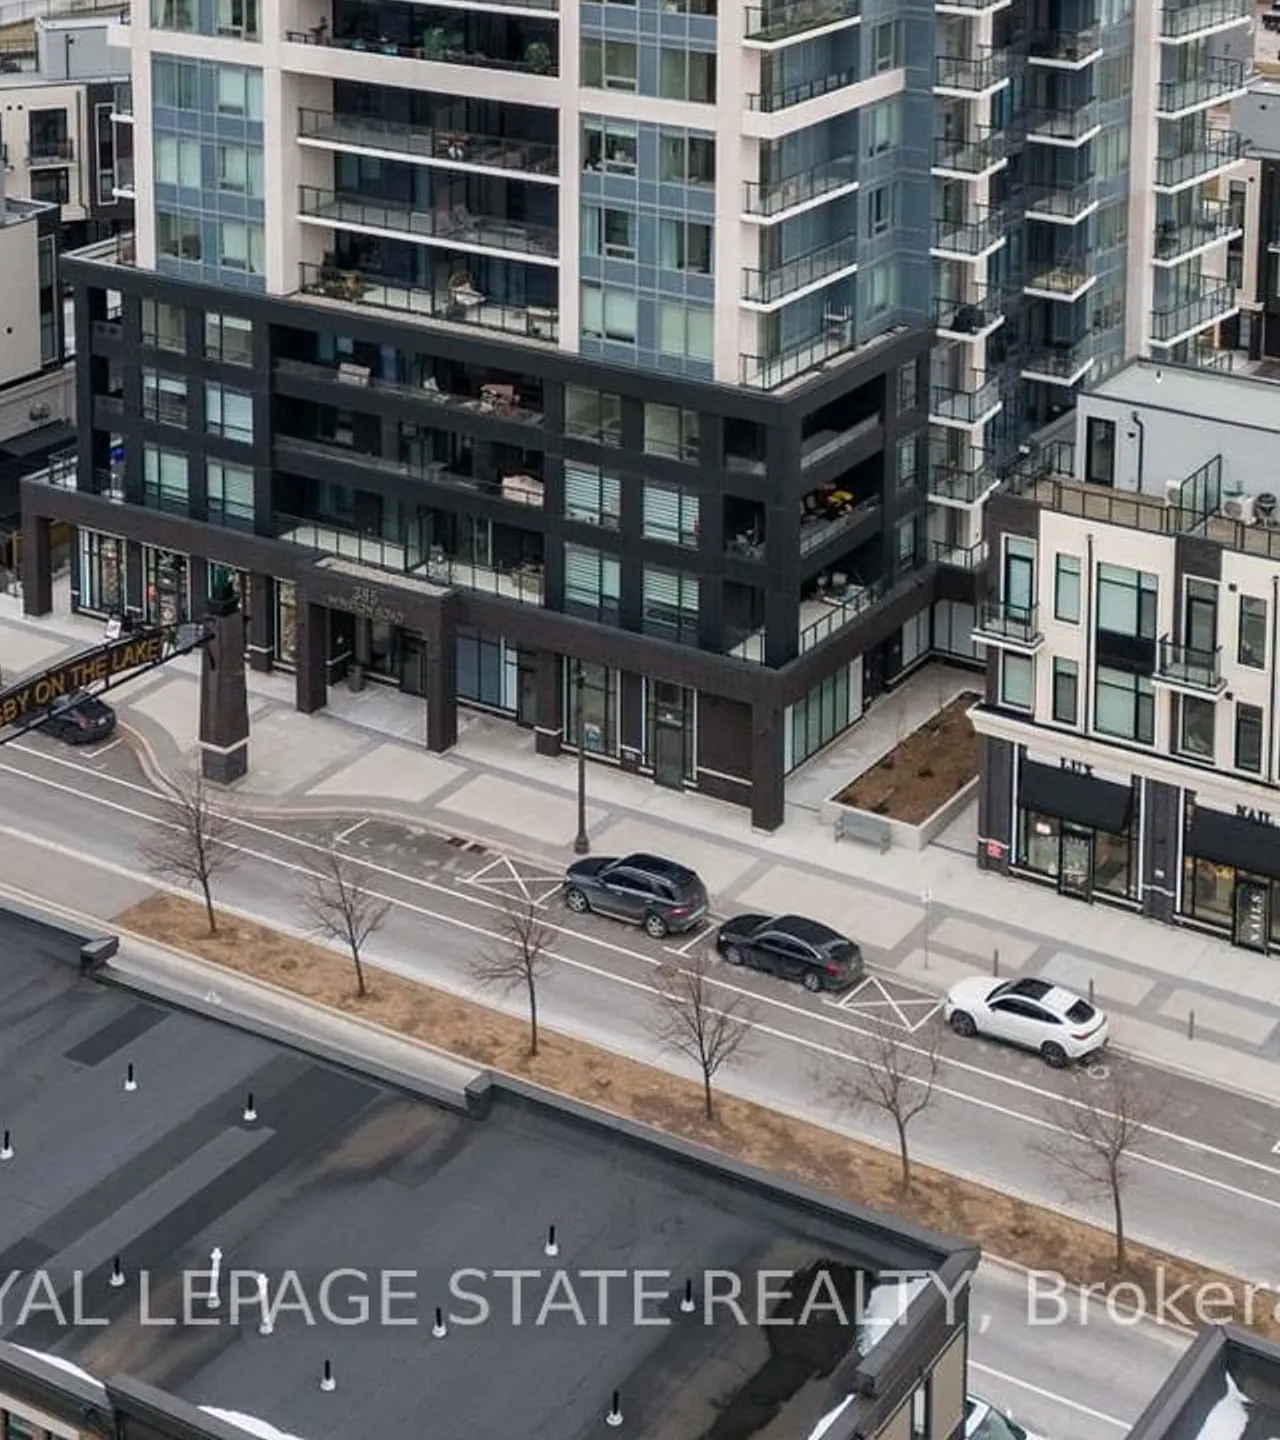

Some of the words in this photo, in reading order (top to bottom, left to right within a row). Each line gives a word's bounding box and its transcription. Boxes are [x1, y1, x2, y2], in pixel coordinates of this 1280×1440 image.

[35, 673, 66, 703] ON
[71, 656, 108, 686] THE
[111, 637, 161, 674] LAKE
[1059, 757, 1095, 777] LUX
[1236, 804, 1276, 827] NAIL
[1250, 894, 1263, 943] NAILS
